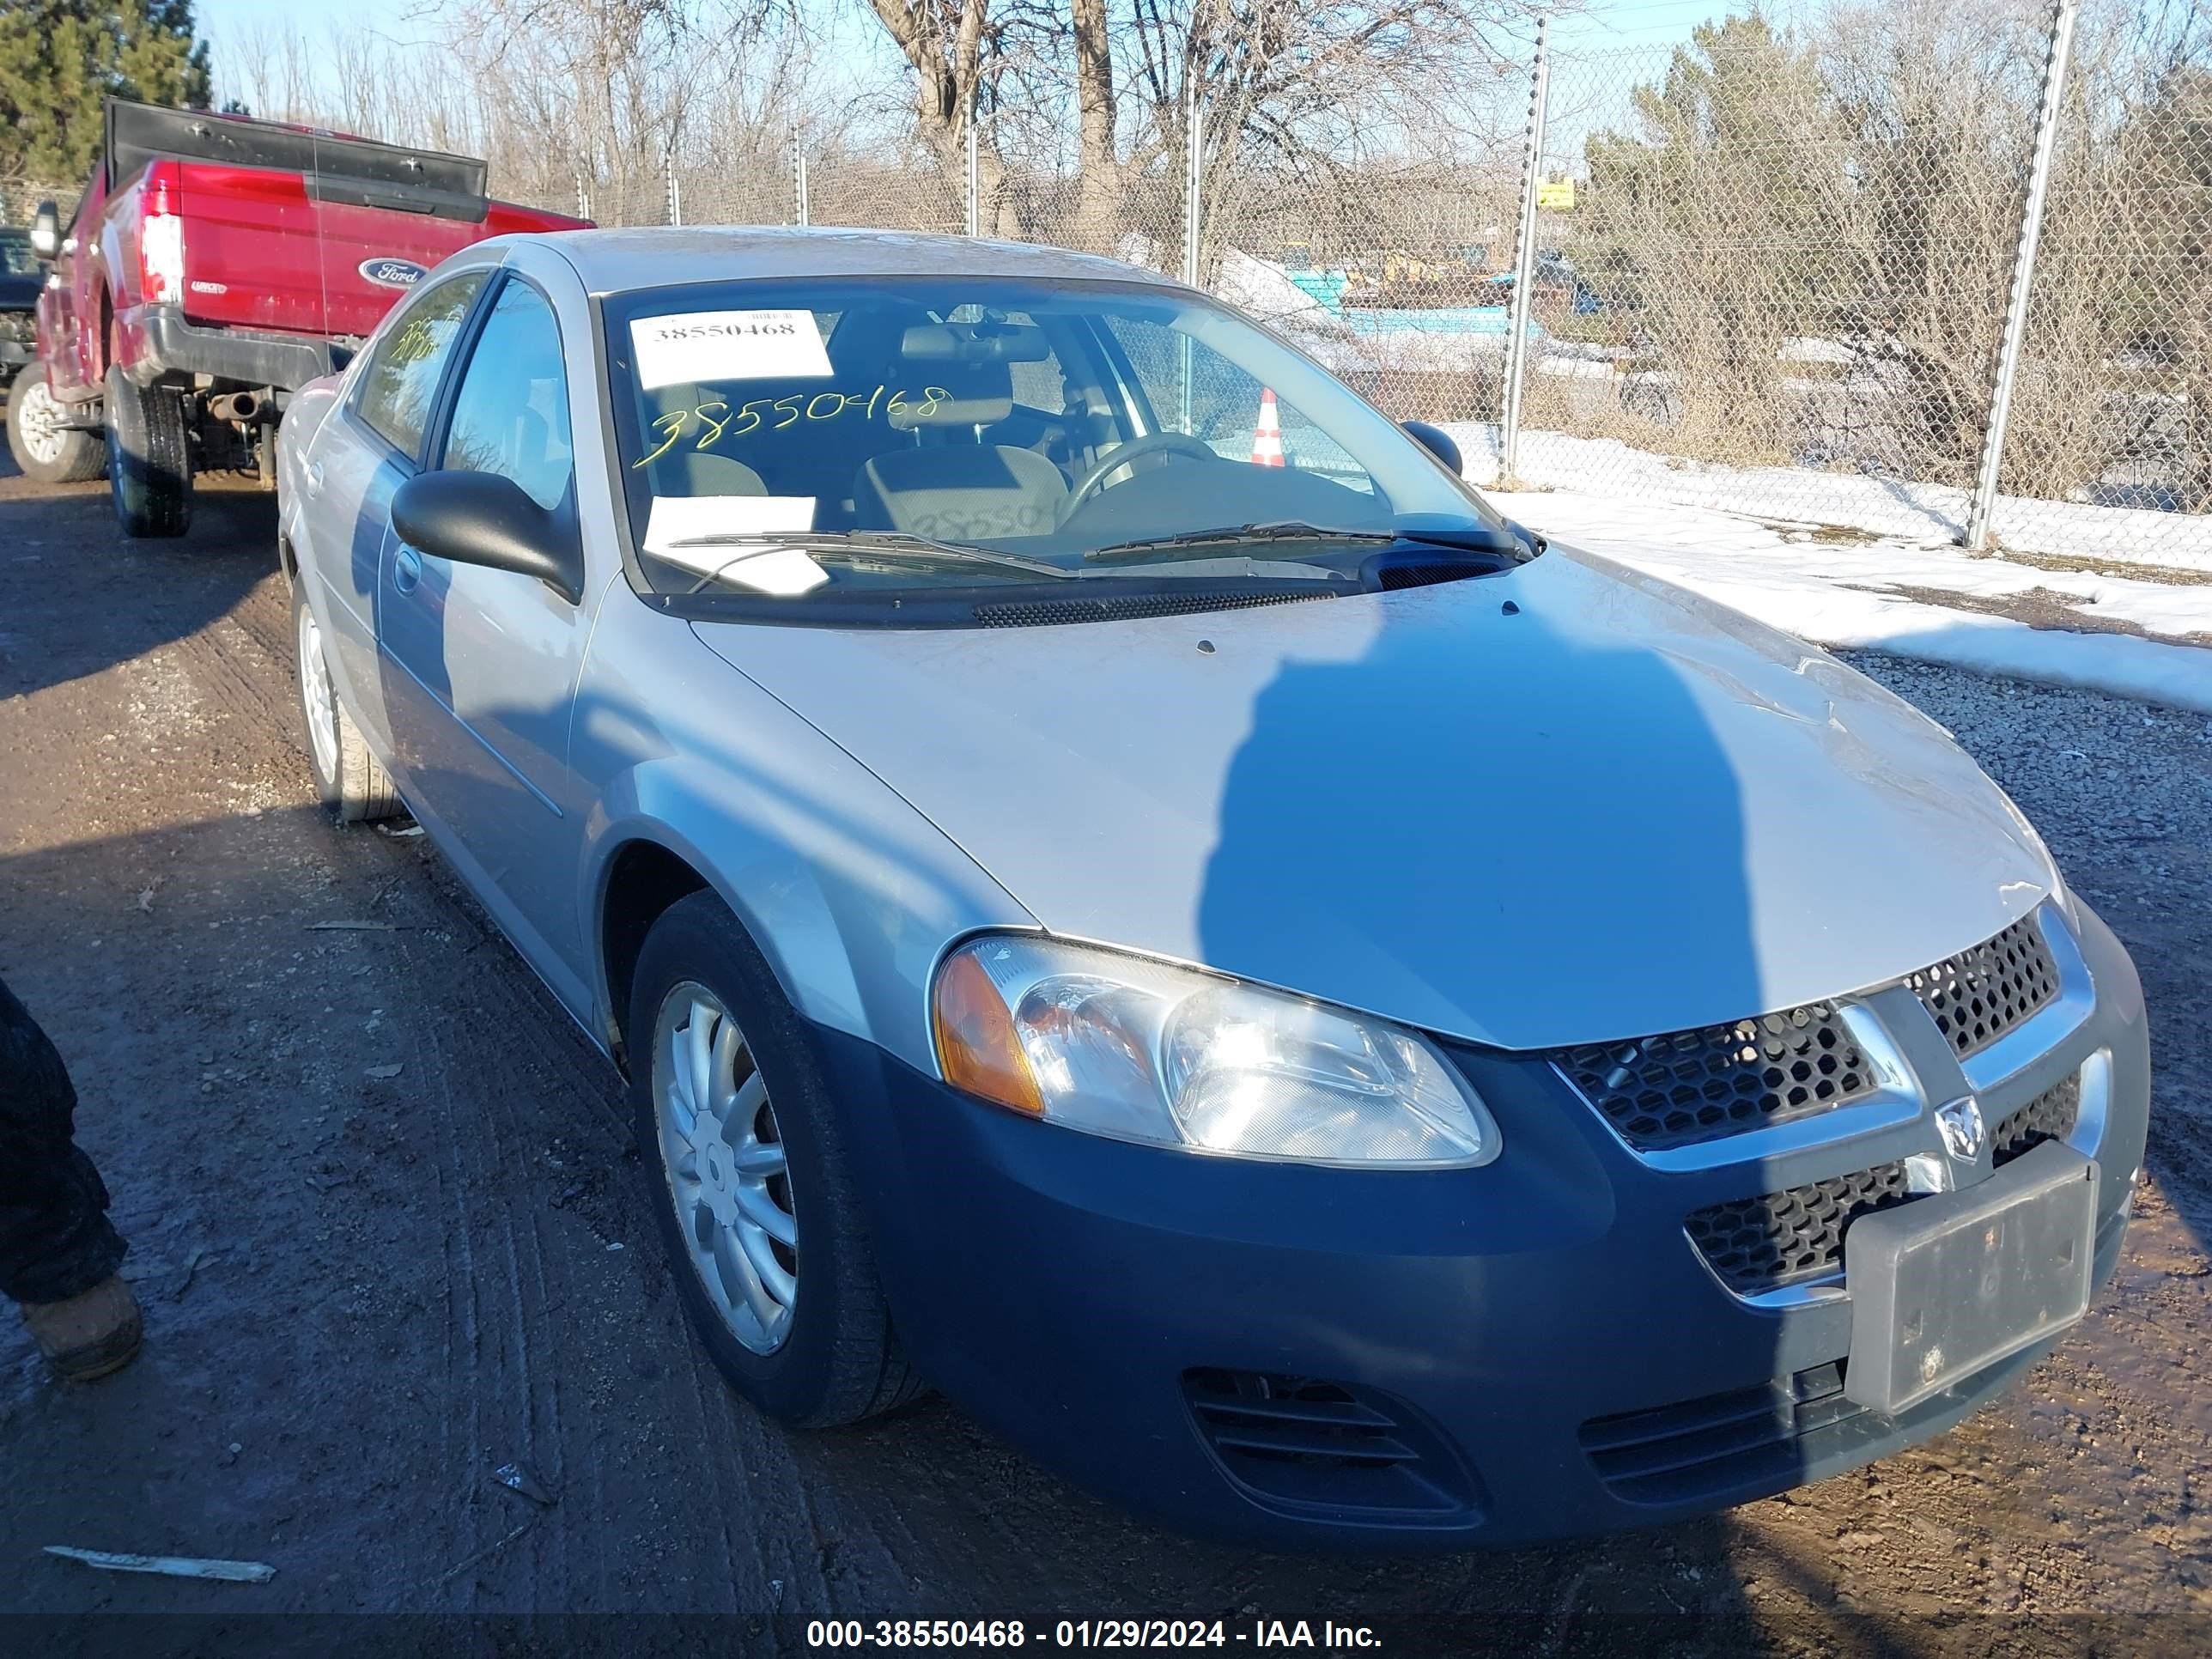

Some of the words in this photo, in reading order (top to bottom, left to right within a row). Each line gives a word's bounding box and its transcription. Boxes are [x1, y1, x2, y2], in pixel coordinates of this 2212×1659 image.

[378, 263, 418, 283] Ford
[653, 322, 797, 343] 38550468
[631, 385, 955, 469] 38550468
